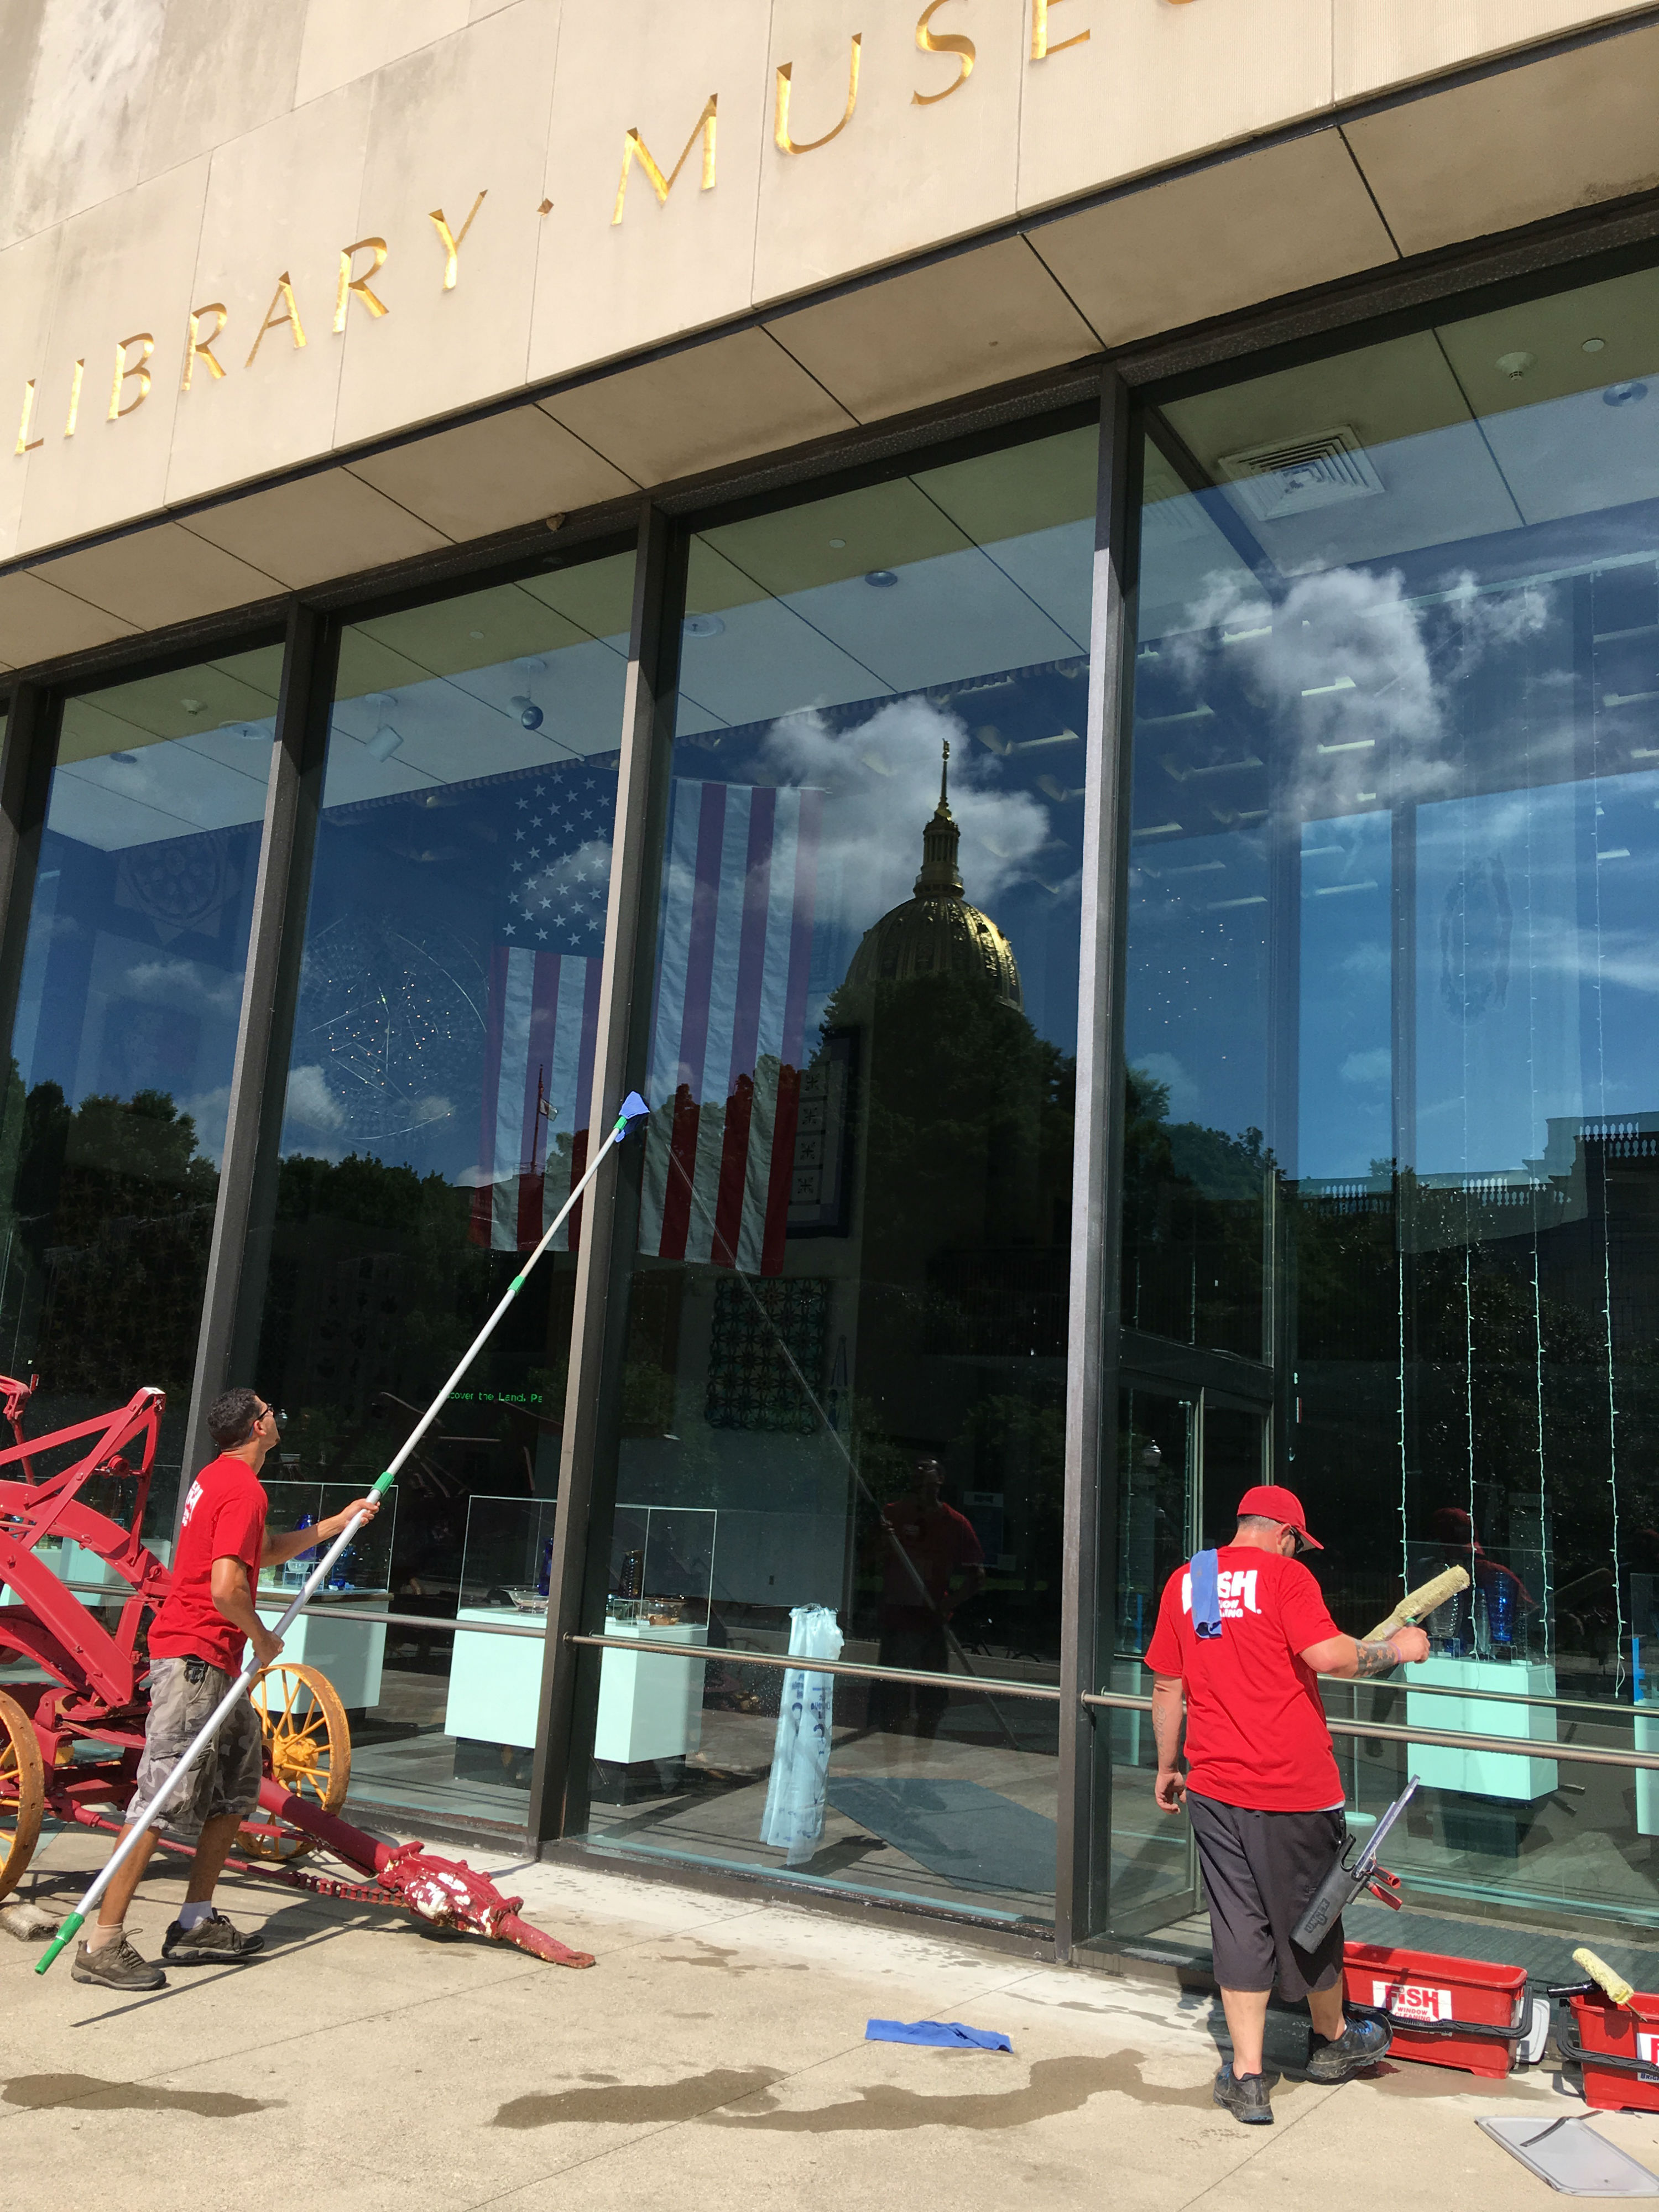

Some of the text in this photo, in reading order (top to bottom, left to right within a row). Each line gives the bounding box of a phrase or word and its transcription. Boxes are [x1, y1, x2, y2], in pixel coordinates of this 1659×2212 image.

[14, 0, 1197, 456] LIBRARY MUSE
[478, 1392, 494, 1400] the
[1305, 1898, 1331, 1934] UNGER
[1397, 2006, 1428, 2015] WINDOW
